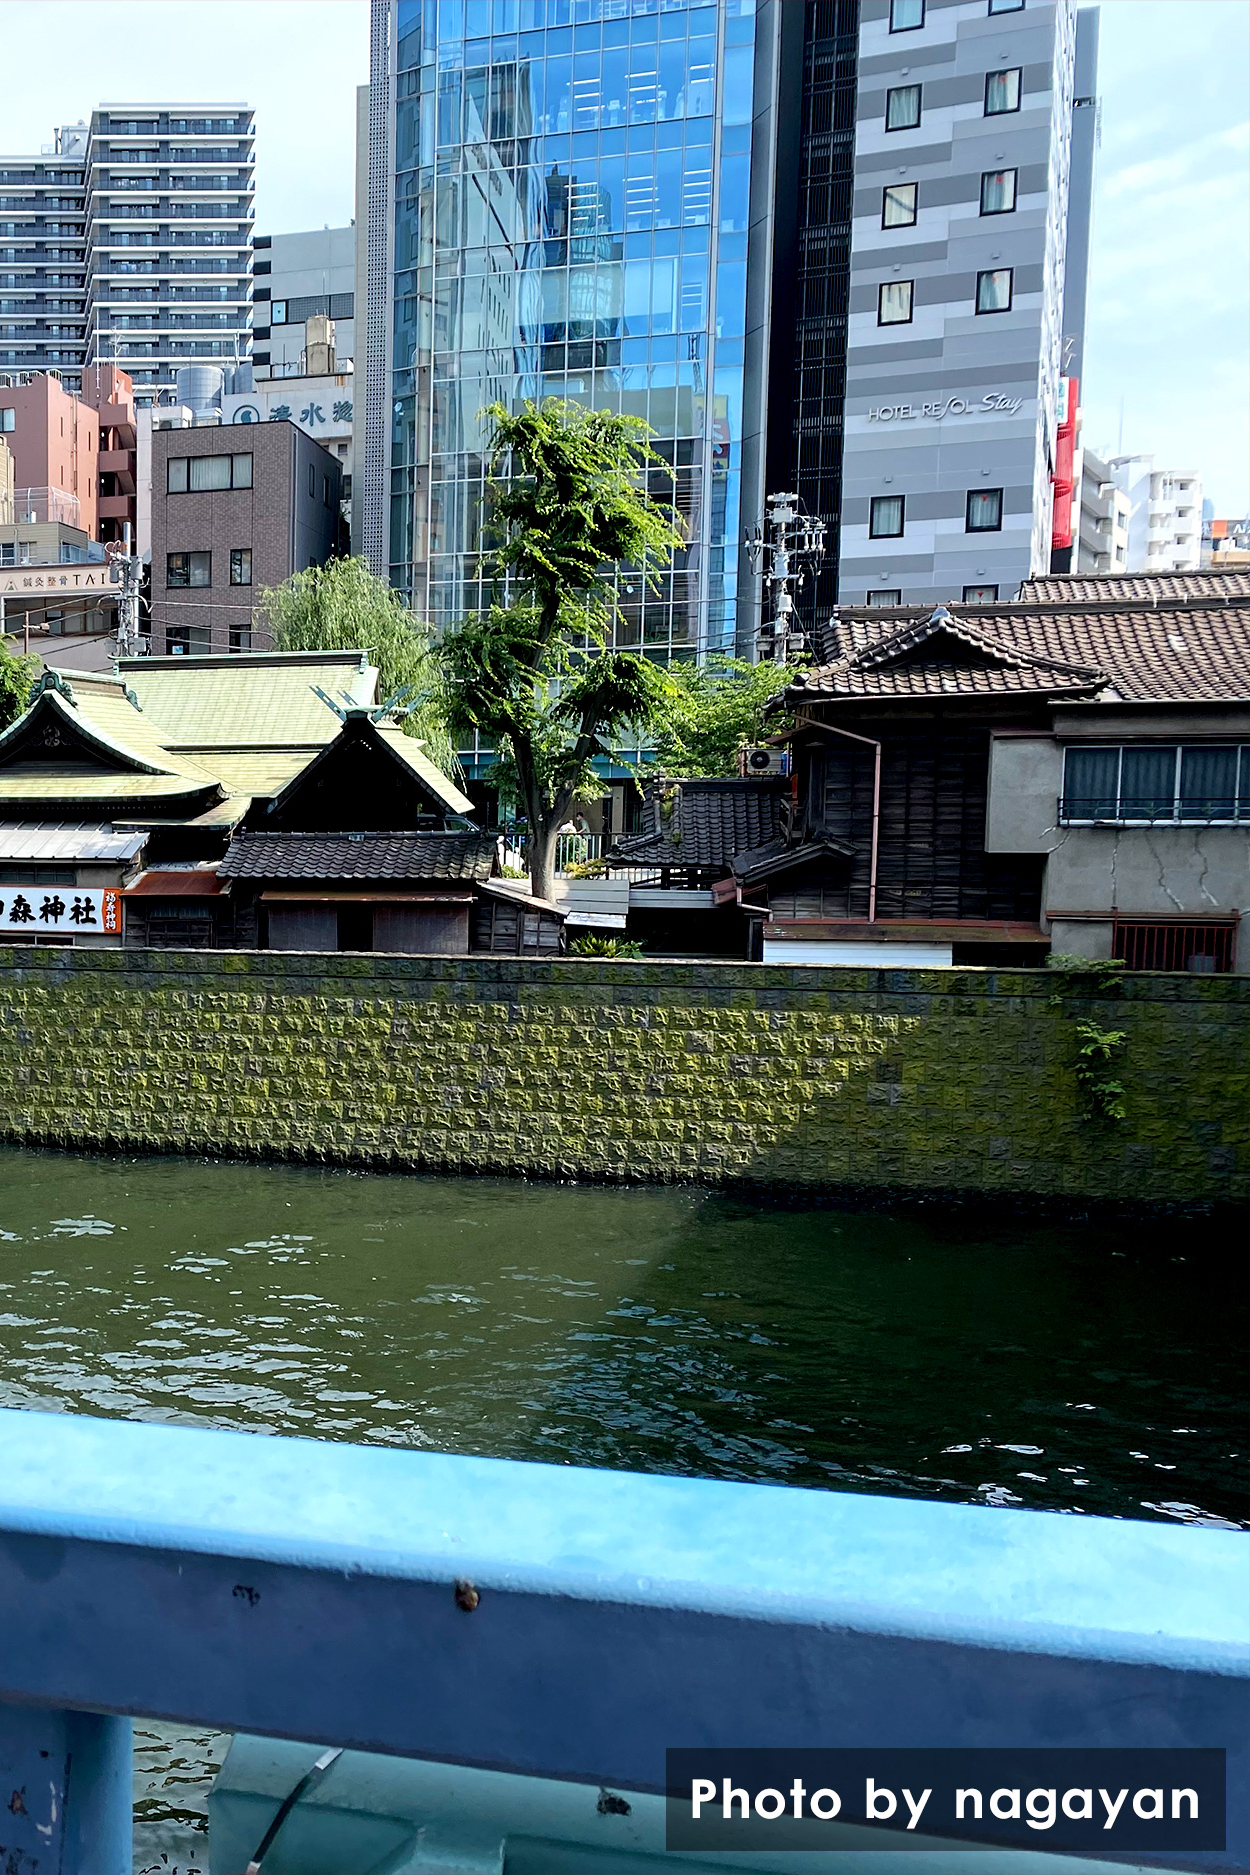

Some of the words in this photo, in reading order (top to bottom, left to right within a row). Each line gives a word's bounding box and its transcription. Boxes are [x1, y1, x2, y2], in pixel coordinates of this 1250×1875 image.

[869, 404, 917, 422] HOTEL
[922, 395, 973, 420] RESOL
[980, 392, 1023, 415] Stay
